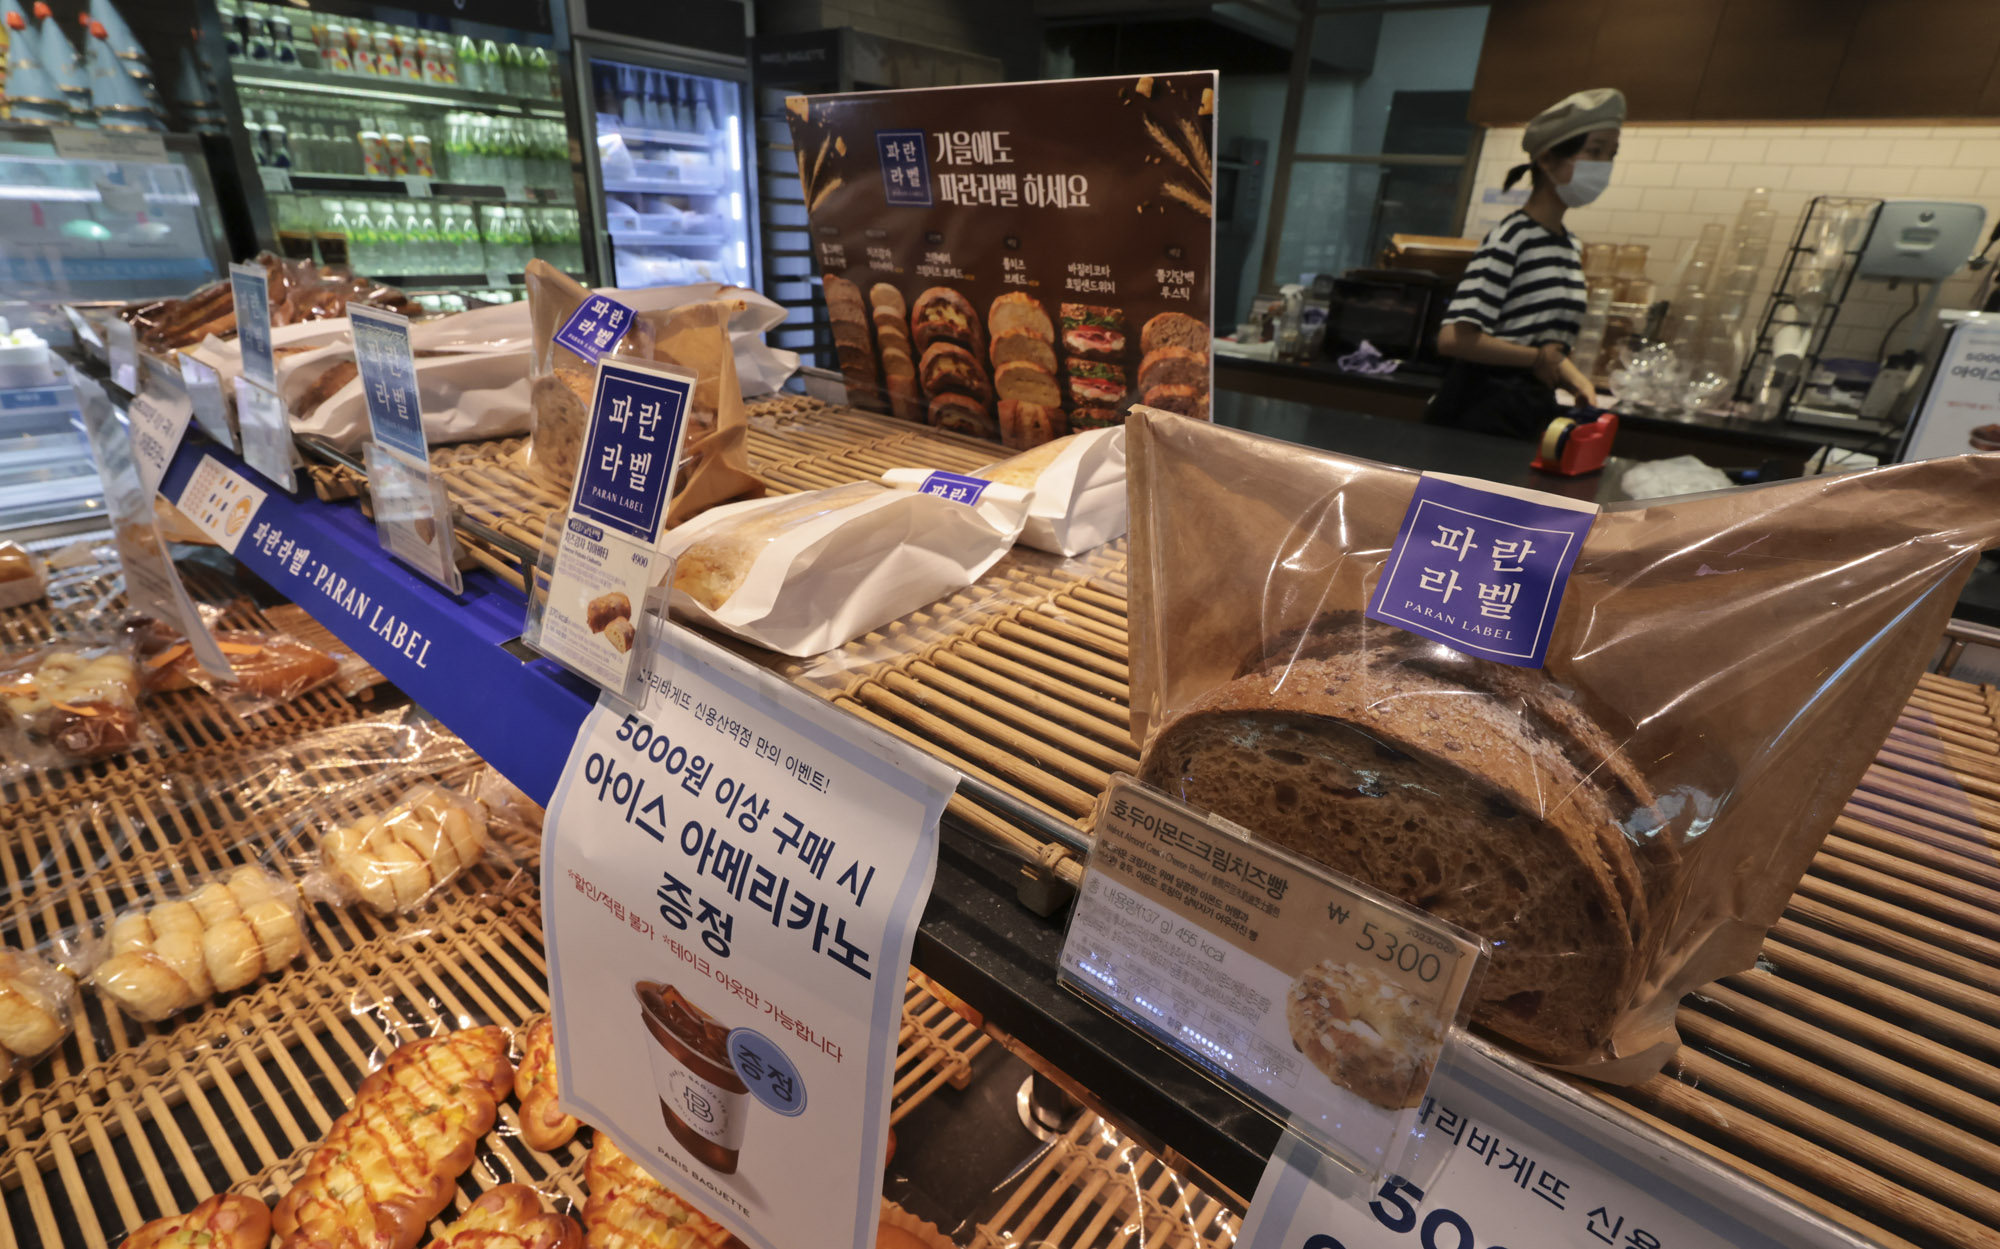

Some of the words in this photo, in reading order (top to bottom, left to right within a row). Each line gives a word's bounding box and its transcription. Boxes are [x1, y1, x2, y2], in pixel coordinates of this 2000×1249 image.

[886, 142, 916, 162] 파란
[933, 131, 1014, 164] 가을에도
[891, 167, 920, 187] 라벨
[938, 174, 1018, 207] 파란라벨
[1023, 174, 1090, 208] 하세요
[578, 319, 614, 348] 라벨
[591, 300, 624, 328] 파란
[375, 378, 409, 420] 라벨
[609, 395, 662, 441] 파란
[601, 443, 652, 492] 라벨
[929, 484, 967, 500] 파란
[592, 486, 617, 503] PARAN
[619, 496, 644, 513] LABEL
[632, 552, 649, 568] 4900
[1431, 525, 1536, 572] 파란
[313, 564, 371, 620] PARAN
[369, 606, 432, 668] LABEL
[1419, 567, 1521, 620] 라벨
[1404, 600, 1455, 625] PARAN
[1462, 621, 1513, 641] LABEL
[695, 702, 753, 748] 신용산역점
[755, 737, 781, 766] 만의
[785, 756, 831, 794] 이벤트!
[615, 714, 714, 797] 5000원
[715, 778, 770, 833] 이상
[772, 812, 836, 880] 구매
[836, 860, 876, 907] 시
[1110, 799, 1289, 900] 호두아몬드크림치즈빵
[1124, 831, 1147, 849] Almond
[585, 753, 667, 843] 아이스
[680, 821, 871, 980] 아메리카노
[1128, 854, 1157, 875] 크림치즈
[1160, 869, 1174, 883] 위에
[1200, 890, 1223, 909] 아몬드
[657, 872, 733, 958] 증정
[1087, 878, 1100, 895] 총
[1160, 918, 1175, 935] g)
[1175, 927, 1198, 948] 455
[1201, 938, 1227, 964] kcal
[1136, 871, 1158, 888] 아몬드
[1216, 911, 1248, 936] 어우러진
[1356, 922, 1441, 983] 5300
[629, 912, 655, 940] 불가
[715, 970, 759, 1009] 아웃만
[764, 1000, 843, 1063] 가능합니다
[739, 1044, 793, 1102] 증정
[657, 1146, 689, 1173] PARIS
[691, 1170, 750, 1217] BAGUETTE
[1368, 1174, 1508, 1249] 50
